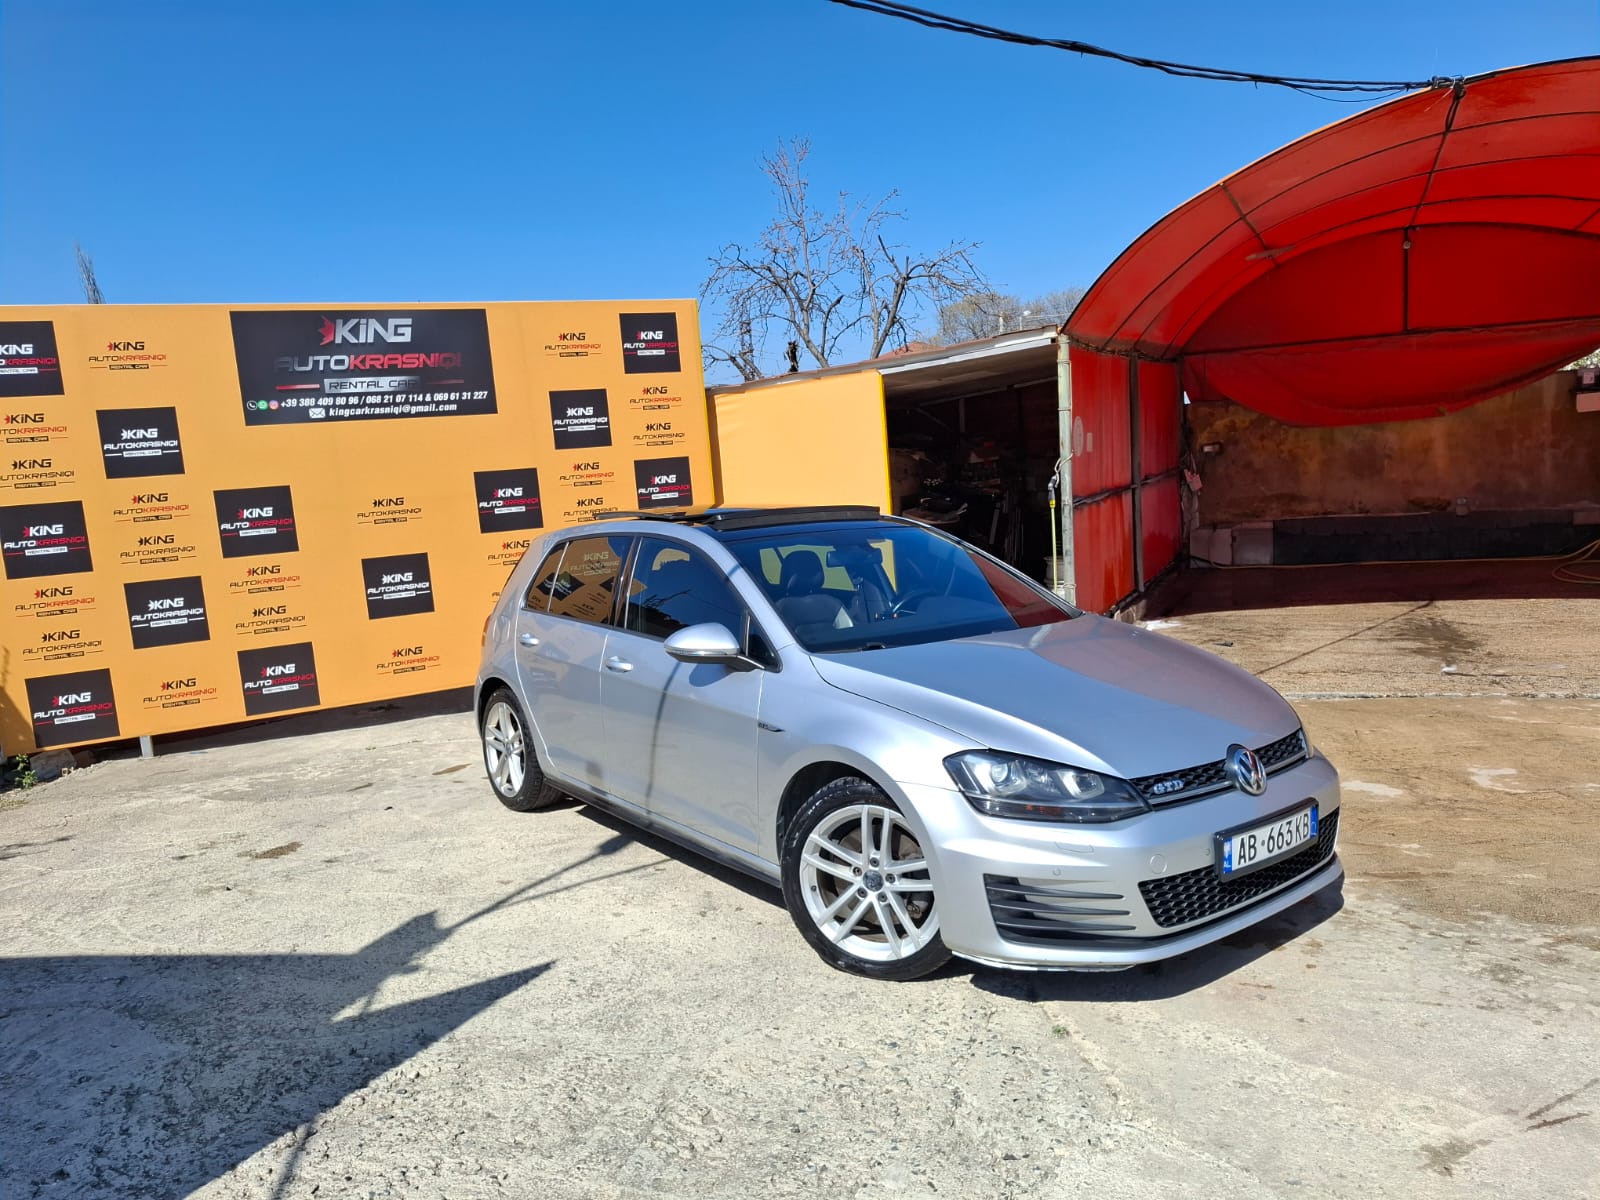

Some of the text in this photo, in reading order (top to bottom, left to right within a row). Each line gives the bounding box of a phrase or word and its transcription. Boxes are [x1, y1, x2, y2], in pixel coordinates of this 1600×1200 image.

[274, 352, 462, 372] AUTOKRASNIQI
[329, 380, 384, 390] RENTAL
[281, 398, 297, 408] +39
[317, 397, 333, 406] 409
[382, 394, 393, 403] 21
[395, 394, 406, 403] 07
[408, 393, 422, 402] 114
[424, 393, 431, 401] &
[433, 392, 448, 401] 069
[449, 392, 459, 400] 61
[462, 391, 471, 400] 31
[473, 391, 488, 399] 227
[329, 403, 457, 417] kingcarkrasniqi@gmail.com
[0, 426, 67, 435] TOKRASNIQI
[104, 440, 178, 450] AUTOKRASNIQI
[0, 471, 74, 480] UTOKRASNIQI
[113, 504, 189, 515] AUTOKRASNIQI
[1153, 779, 1185, 795] GTD
